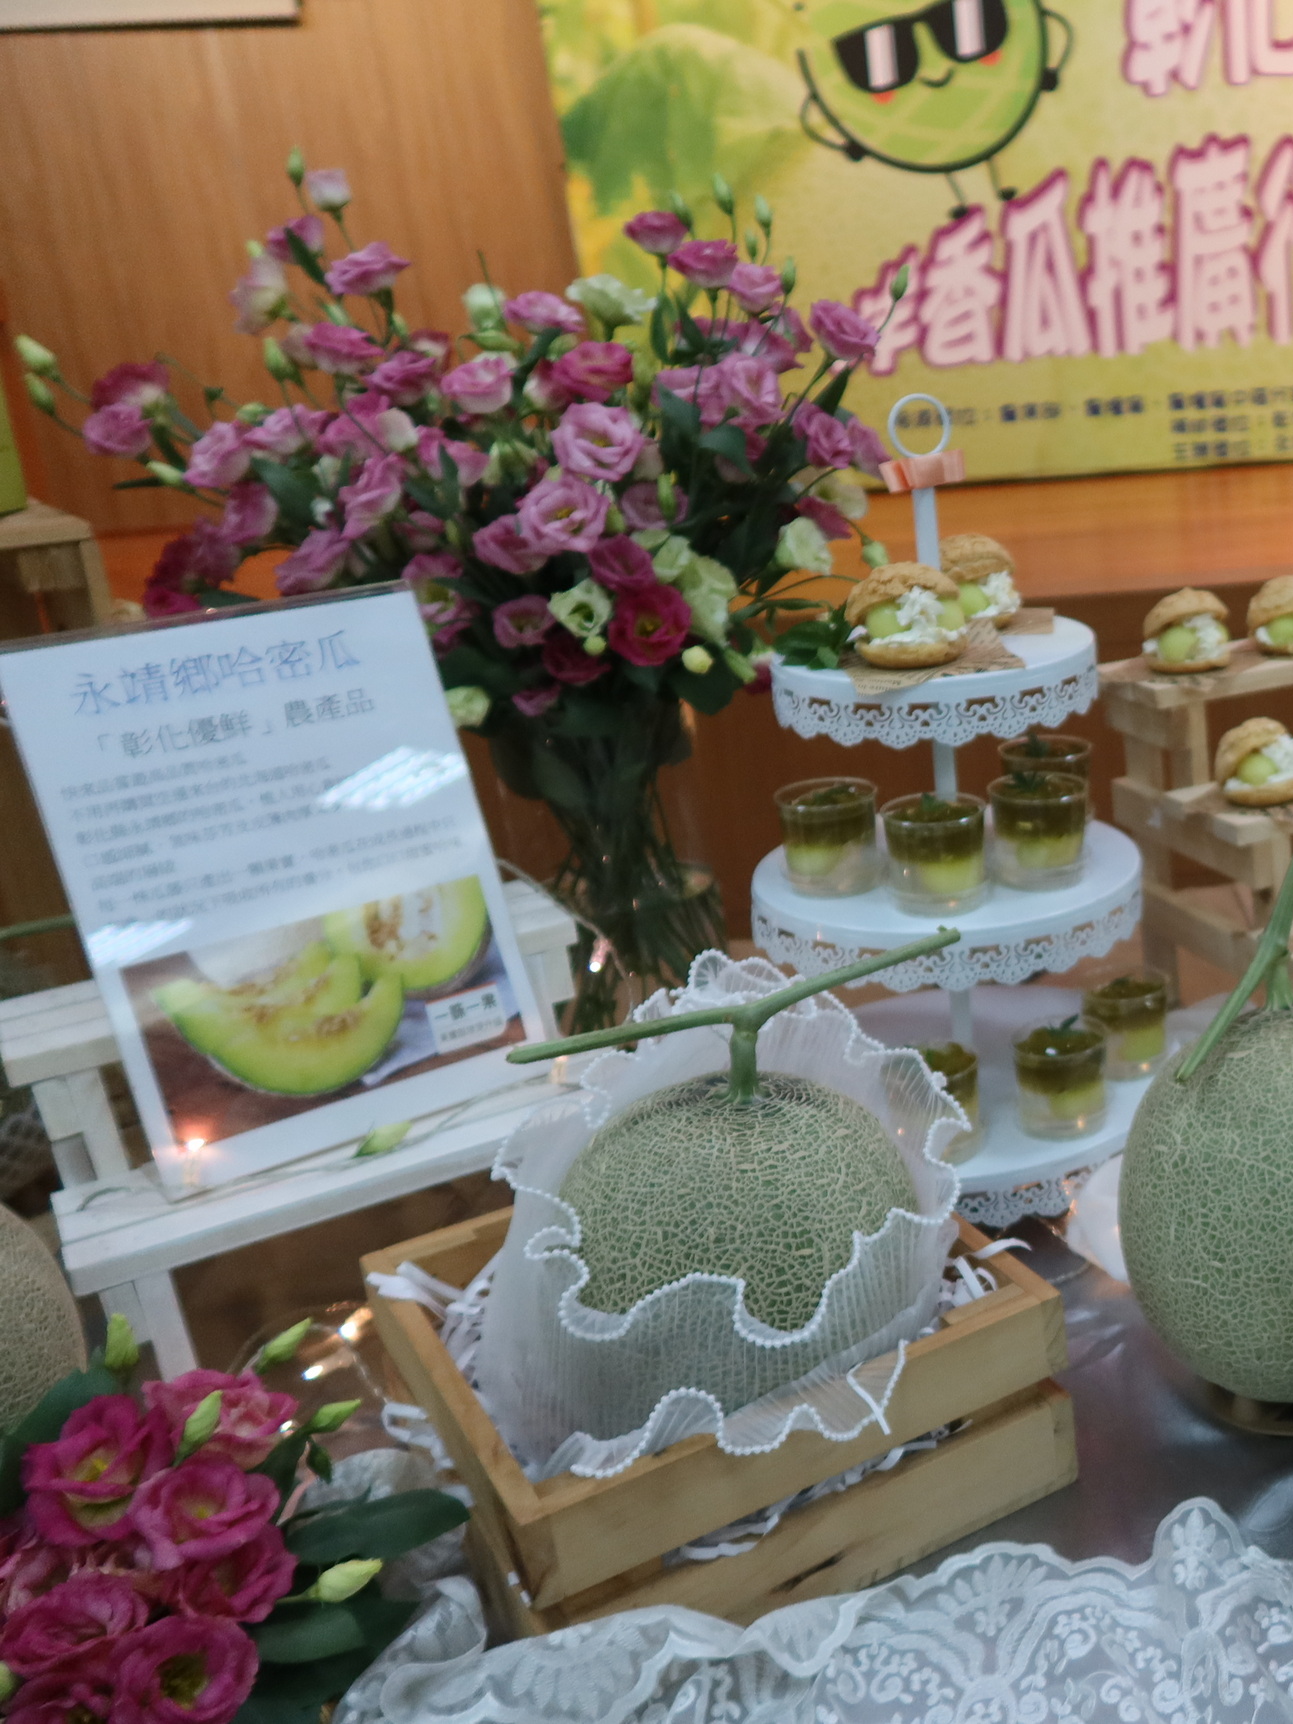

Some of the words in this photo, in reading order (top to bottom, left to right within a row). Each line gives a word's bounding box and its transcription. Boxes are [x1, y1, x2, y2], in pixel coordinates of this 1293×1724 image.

[70, 629, 361, 716] 永靖鄉哈密瓜
